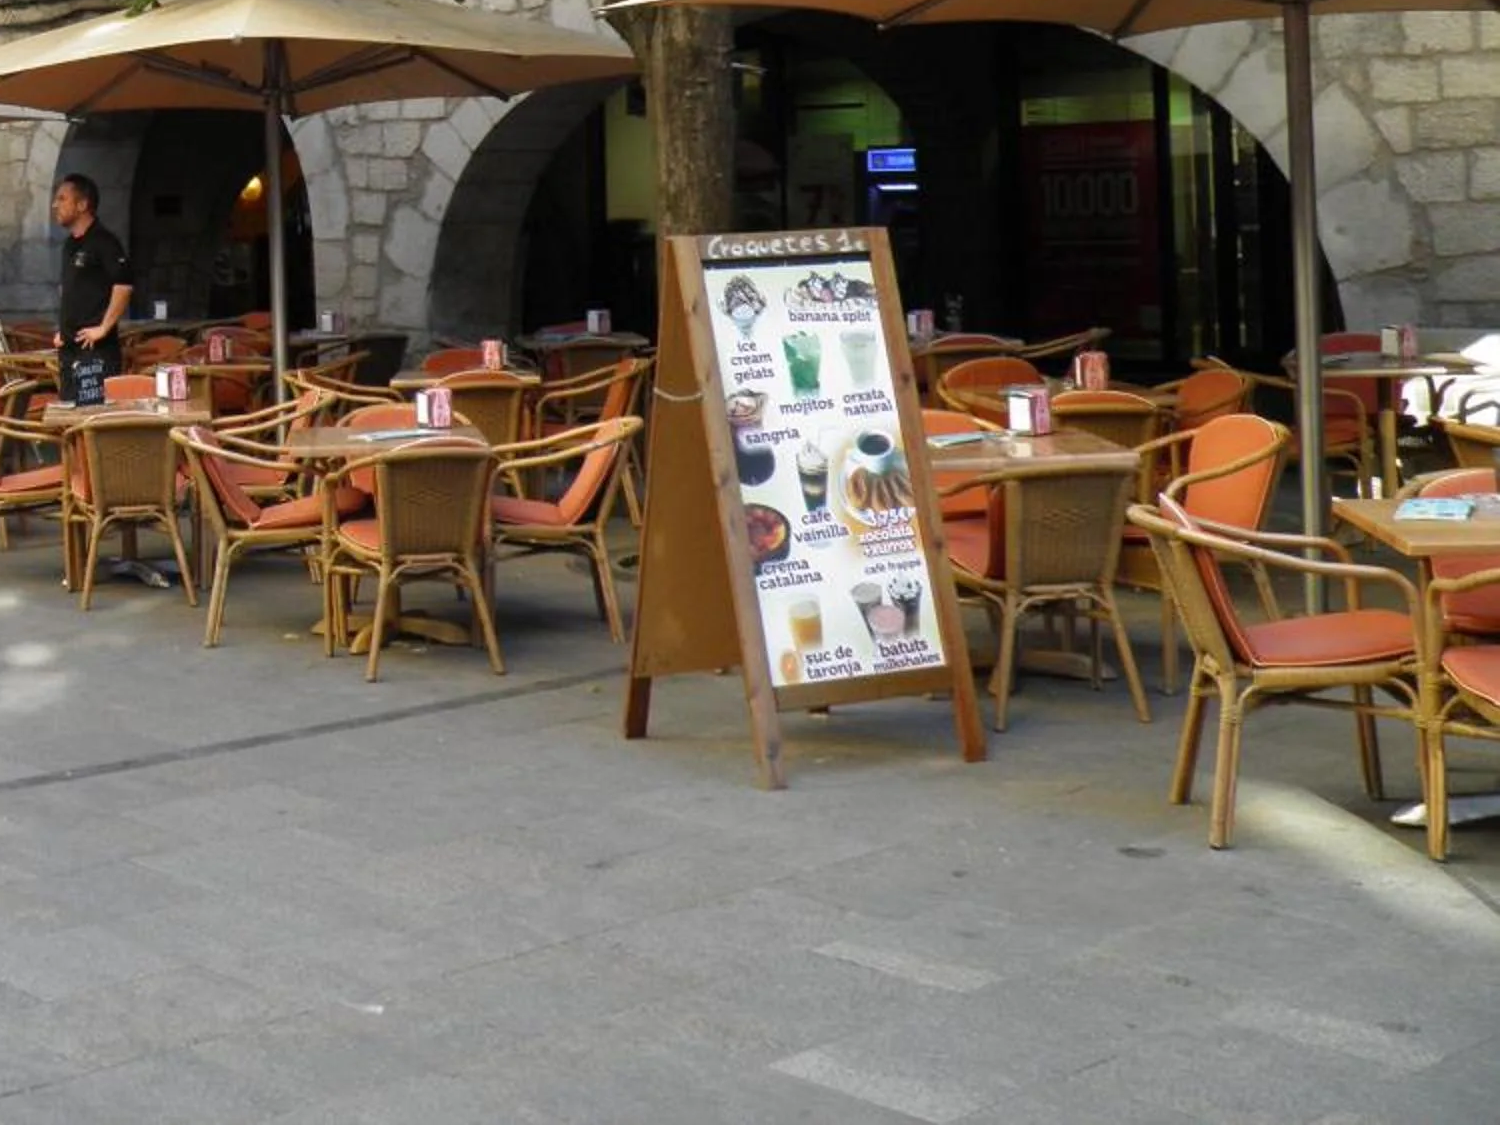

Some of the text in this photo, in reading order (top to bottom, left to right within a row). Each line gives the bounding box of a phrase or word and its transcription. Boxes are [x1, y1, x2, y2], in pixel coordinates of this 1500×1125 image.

[707, 233, 830, 259] Croquetes
[788, 311, 839, 322] banana
[737, 341, 757, 352] ice
[730, 352, 773, 366] cream
[734, 367, 775, 383] gelats
[843, 388, 885, 403] orxata
[779, 399, 835, 416] mojitos
[843, 400, 893, 417] natural
[794, 524, 850, 543] vainilla
[763, 559, 811, 574] crema
[759, 570, 823, 589] catalana
[805, 645, 853, 663] suc de
[879, 639, 929, 657] batuts
[806, 662, 863, 679] taronja
[873, 653, 941, 672] milkshakes
